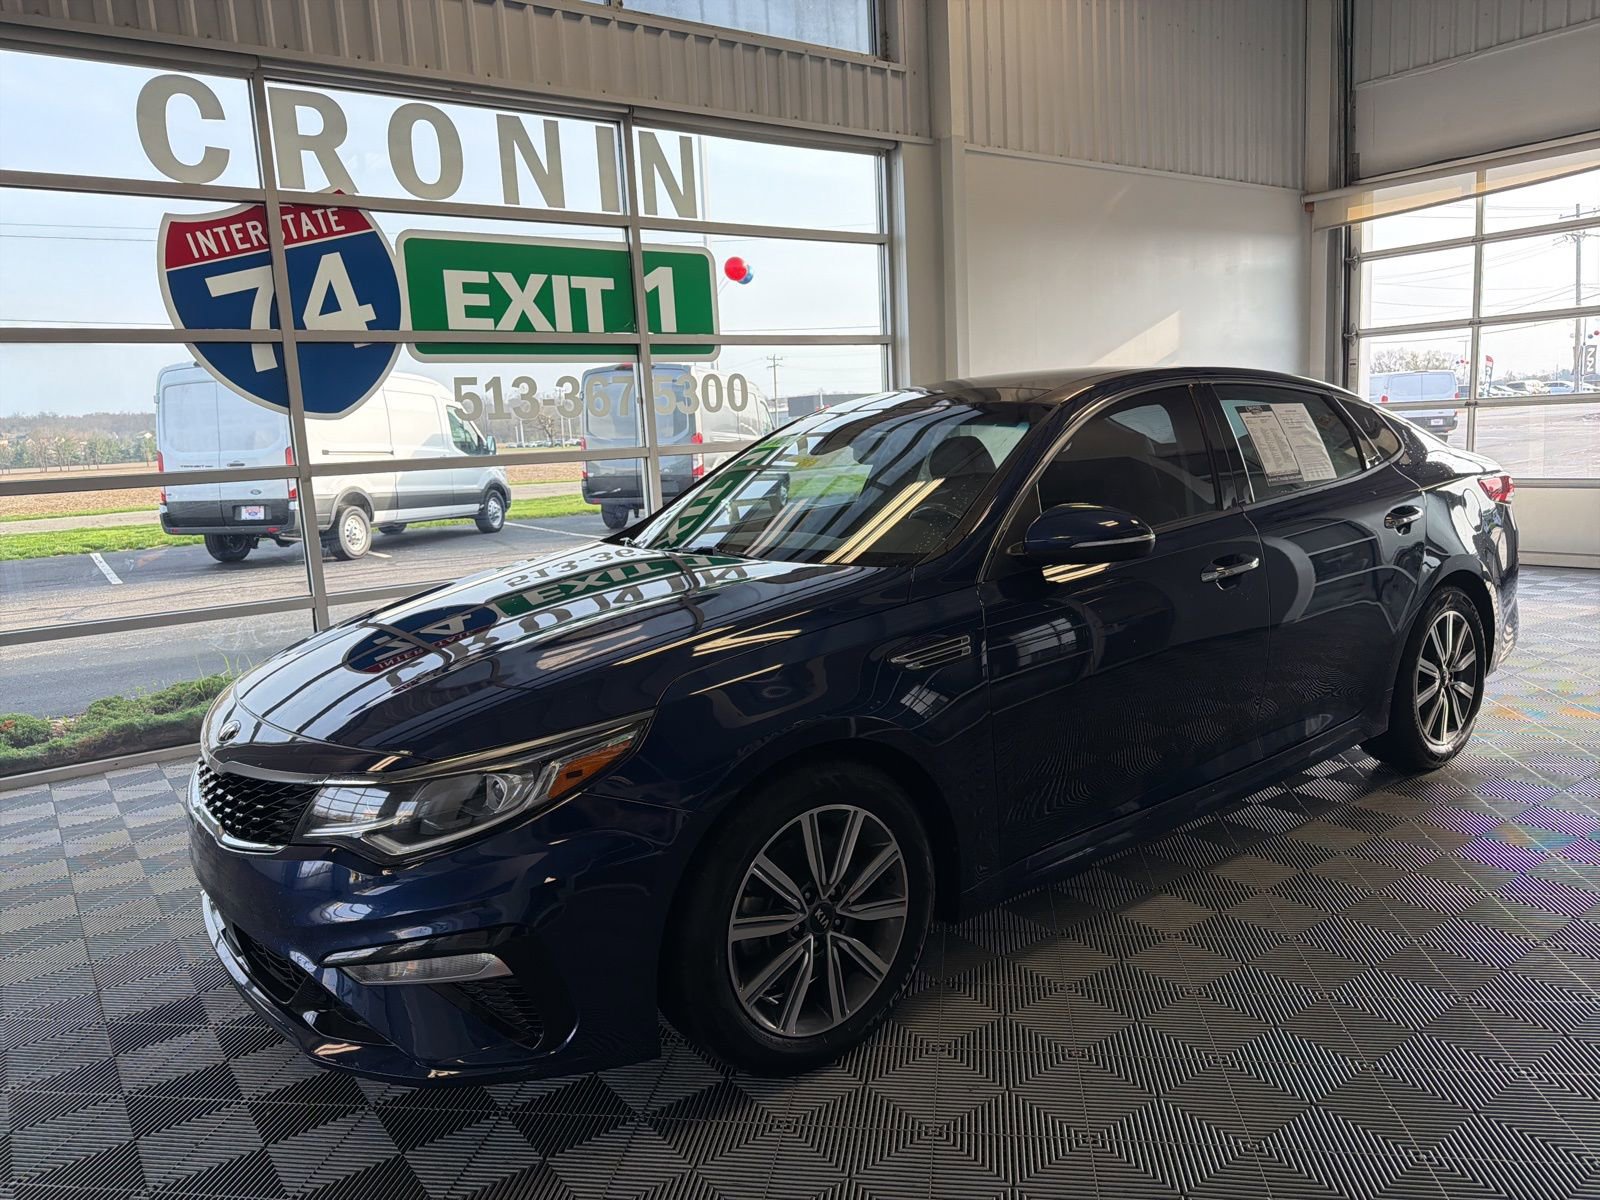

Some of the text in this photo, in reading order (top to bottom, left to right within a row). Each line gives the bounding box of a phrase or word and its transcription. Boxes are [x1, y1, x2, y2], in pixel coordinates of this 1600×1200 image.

[136, 74, 698, 219] CRONIN
[186, 207, 346, 259] INTERTATE
[205, 252, 377, 373] 74
[443, 266, 678, 333] EXIT 1
[453, 373, 749, 422] 513-3675300
